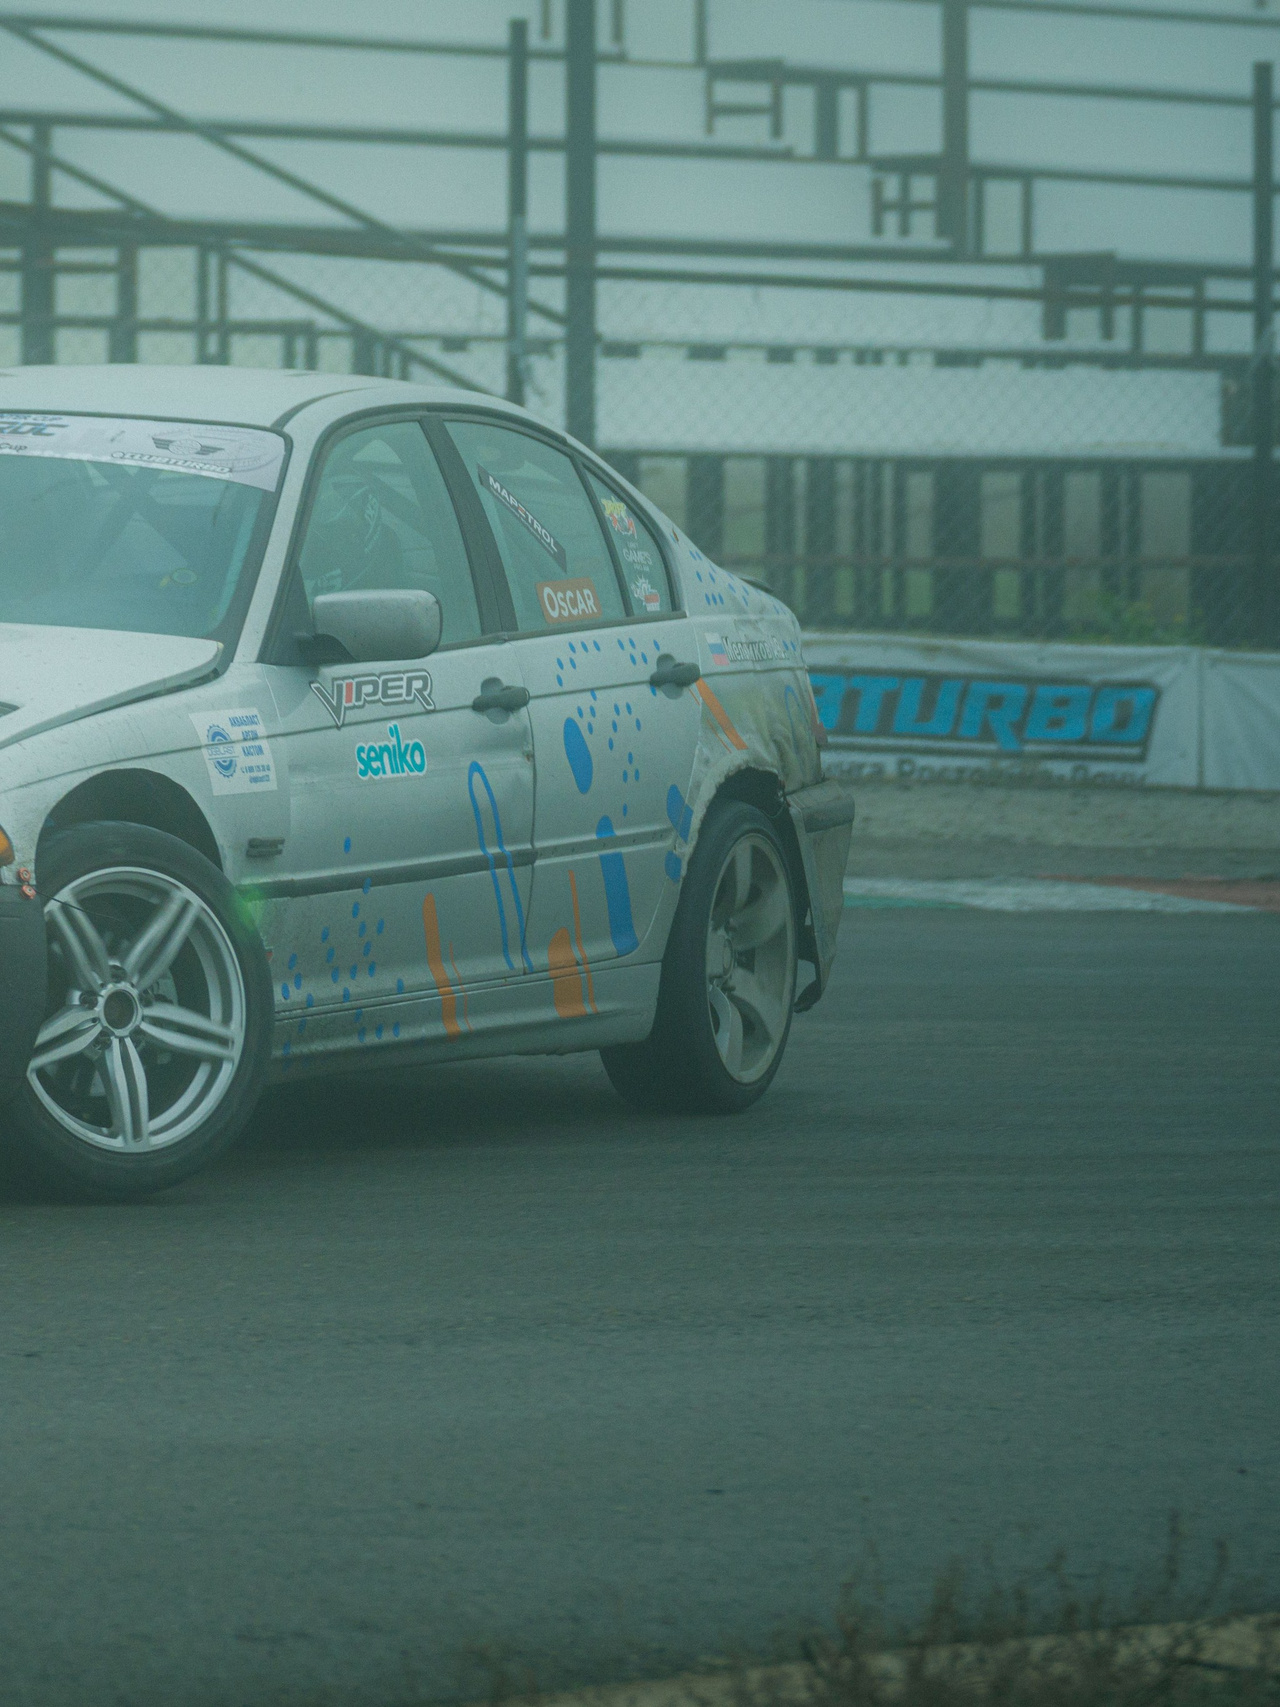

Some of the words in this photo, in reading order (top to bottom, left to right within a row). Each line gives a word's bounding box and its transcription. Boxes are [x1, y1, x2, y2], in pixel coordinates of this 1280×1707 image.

[488, 475, 558, 552] MAPETROL
[543, 585, 599, 618] OSCAR
[309, 668, 436, 730] VIPER
[355, 722, 426, 778] seniko
